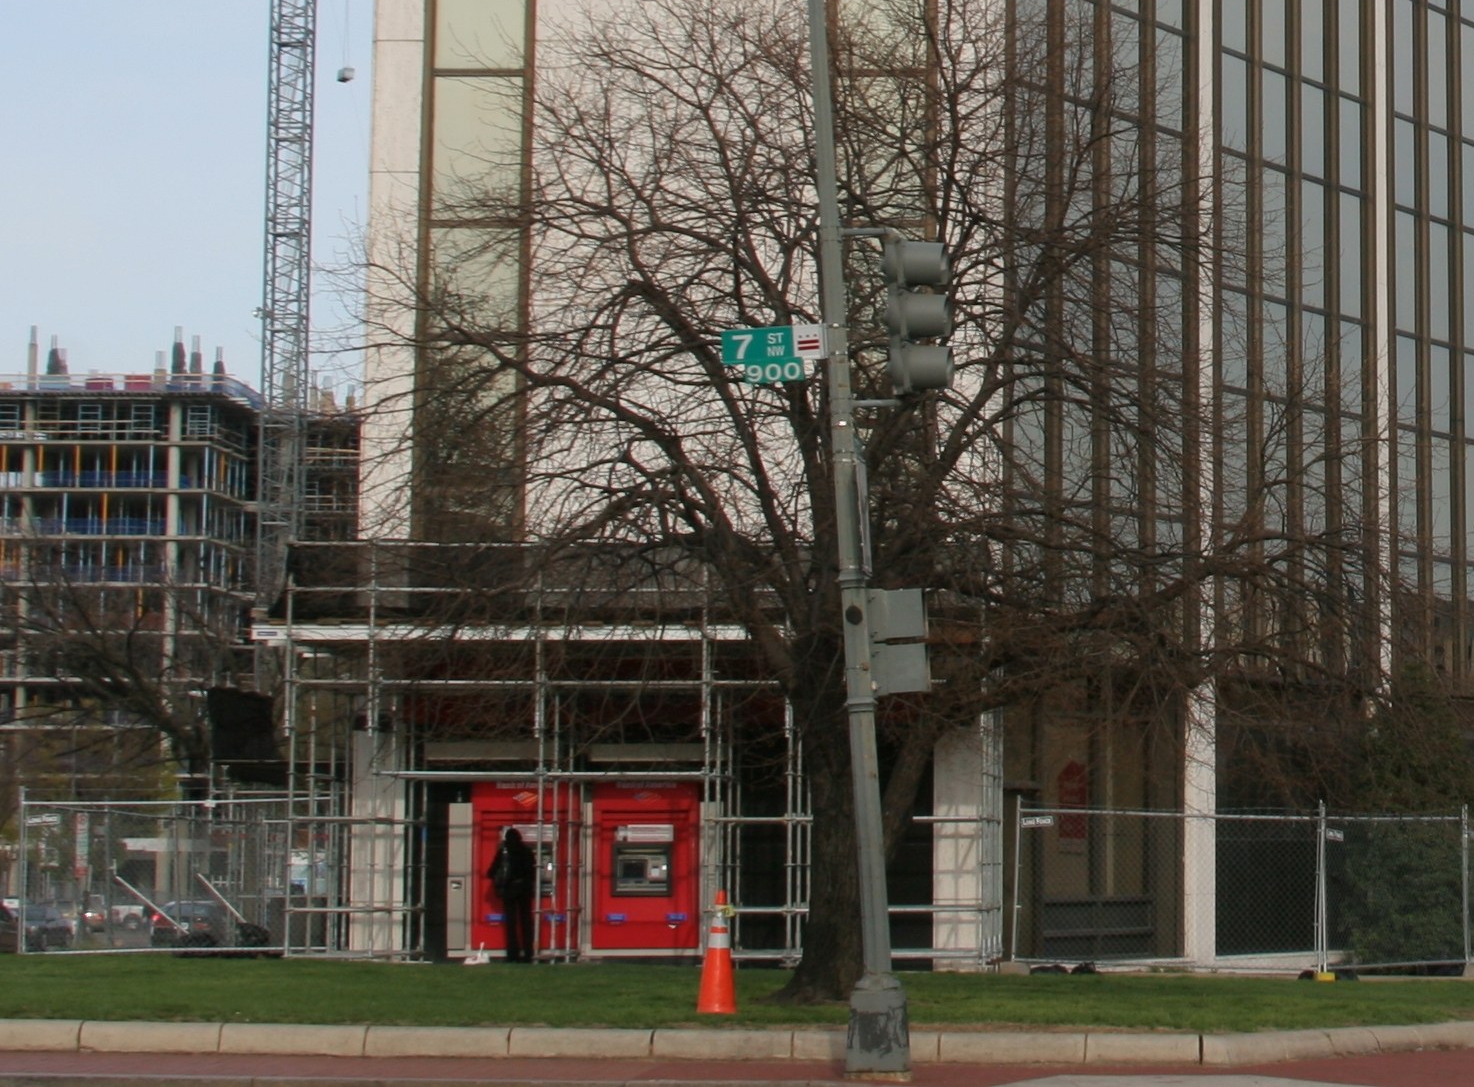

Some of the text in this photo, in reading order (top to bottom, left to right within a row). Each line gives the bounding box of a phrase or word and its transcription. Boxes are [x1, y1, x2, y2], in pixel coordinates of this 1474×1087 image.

[731, 332, 784, 360] 7 ST
[767, 345, 785, 356] NW
[746, 362, 801, 383] 900
